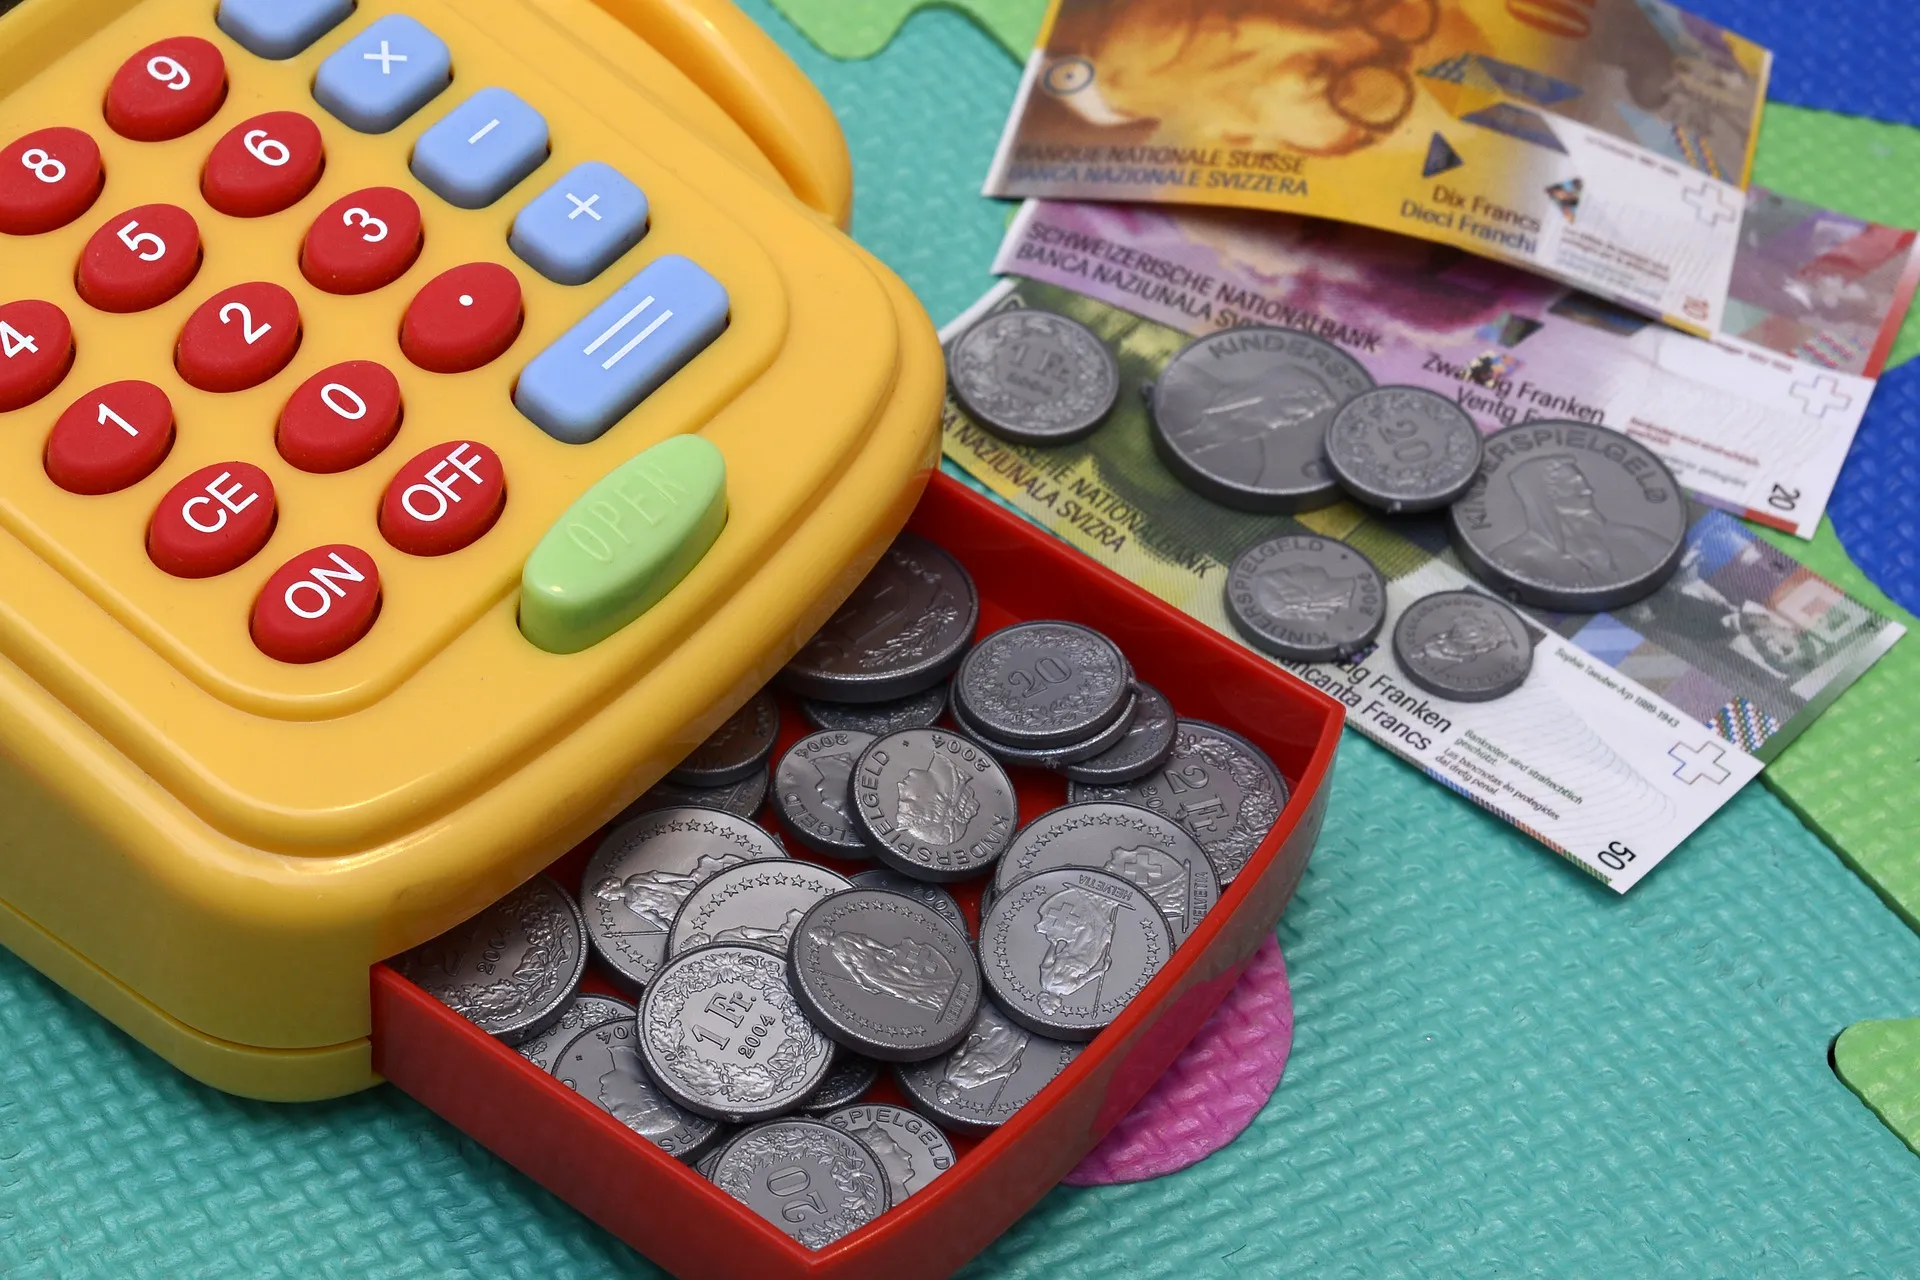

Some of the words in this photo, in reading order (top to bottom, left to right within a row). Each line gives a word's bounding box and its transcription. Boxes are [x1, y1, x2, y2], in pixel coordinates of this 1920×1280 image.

[146, 55, 191, 90] 9
[21, 148, 67, 183] 8
[243, 129, 291, 167] 6
[1228, 149, 1307, 176] SUISSE
[1205, 170, 1310, 197] SVIZZERA
[342, 207, 389, 243] 3
[1400, 198, 1455, 229] Dieci
[1458, 214, 1538, 254] Franchi
[1432, 183, 1467, 209] Dix
[1471, 194, 1542, 234] Francs
[116, 219, 167, 262] 5
[1015, 242, 1091, 278] BANCA
[1092, 264, 1212, 323] NAZIUNALA
[1030, 221, 1216, 297] SCHWEIZERISCHE
[1216, 282, 1382, 353] NATIONALBANK
[0, 320, 39, 358] 4
[218, 301, 272, 345] 2
[97, 402, 139, 437] 1
[320, 382, 367, 420] 0
[1517, 380, 1607, 425] Franken
[1377, 418, 1433, 463] 20
[181, 471, 259, 534] CE
[401, 442, 484, 522] OFF
[954, 423, 1063, 509] NAZIUNALA
[1056, 499, 1129, 553] SVIZRA
[1466, 428, 1670, 532] KINDERSPIELGELD
[1767, 482, 1802, 512] 20
[565, 461, 692, 564] OPEN
[284, 551, 366, 619] ON
[1234, 538, 1331, 645] KINDERSPIELGELD
[1007, 654, 1074, 700] 20
[1361, 699, 1433, 752] Francs
[1369, 673, 1453, 735] Franken
[794, 732, 849, 760] 2004
[930, 732, 991, 773] 2004
[1464, 728, 1510, 761] Banknoten
[1508, 756, 1530, 773] sind
[1526, 767, 1585, 806] strafrechtlich
[1163, 764, 1210, 796] 2
[1448, 763, 1474, 783] dretg
[1469, 776, 1501, 797] penal.
[1458, 756, 1504, 788] bancnotas
[1511, 789, 1561, 822] protegidas
[860, 749, 1011, 867] KINDERSPIELGELD
[1596, 839, 1638, 872] 50
[1078, 873, 1134, 902] HELVETIA
[704, 990, 758, 1029] Fr.
[691, 1023, 732, 1051] 1
[737, 1013, 777, 1060] 2004
[829, 1106, 952, 1172] SPIELGELD
[766, 1164, 829, 1224] 20
